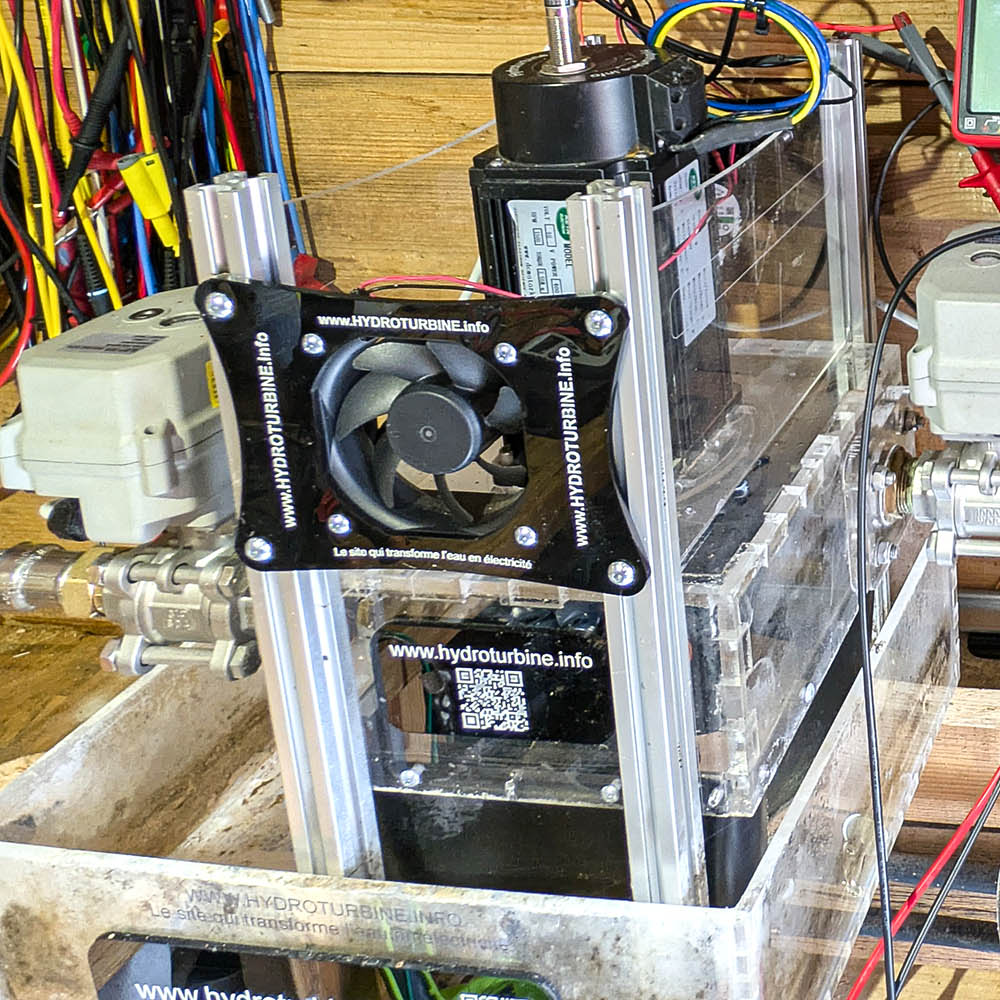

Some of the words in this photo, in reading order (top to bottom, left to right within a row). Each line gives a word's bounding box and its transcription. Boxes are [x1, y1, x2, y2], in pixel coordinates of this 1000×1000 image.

[563, 243, 573, 268] MODEL
[317, 314, 490, 335] www.HYDROTURBINE.info
[256, 331, 298, 530] www.HYDROTURBINE.info
[556, 346, 590, 548] www.HYDROTURBINE.info
[333, 546, 347, 557] Le
[349, 547, 368, 558] site
[368, 547, 385, 560] qui
[385, 548, 440, 560] transforme
[441, 550, 467, 562] l'eau
[468, 555, 482, 563] en
[386, 639, 594, 670] www.hydroturbine.info
[150, 903, 171, 919] Le
[244, 912, 340, 936] transforme
